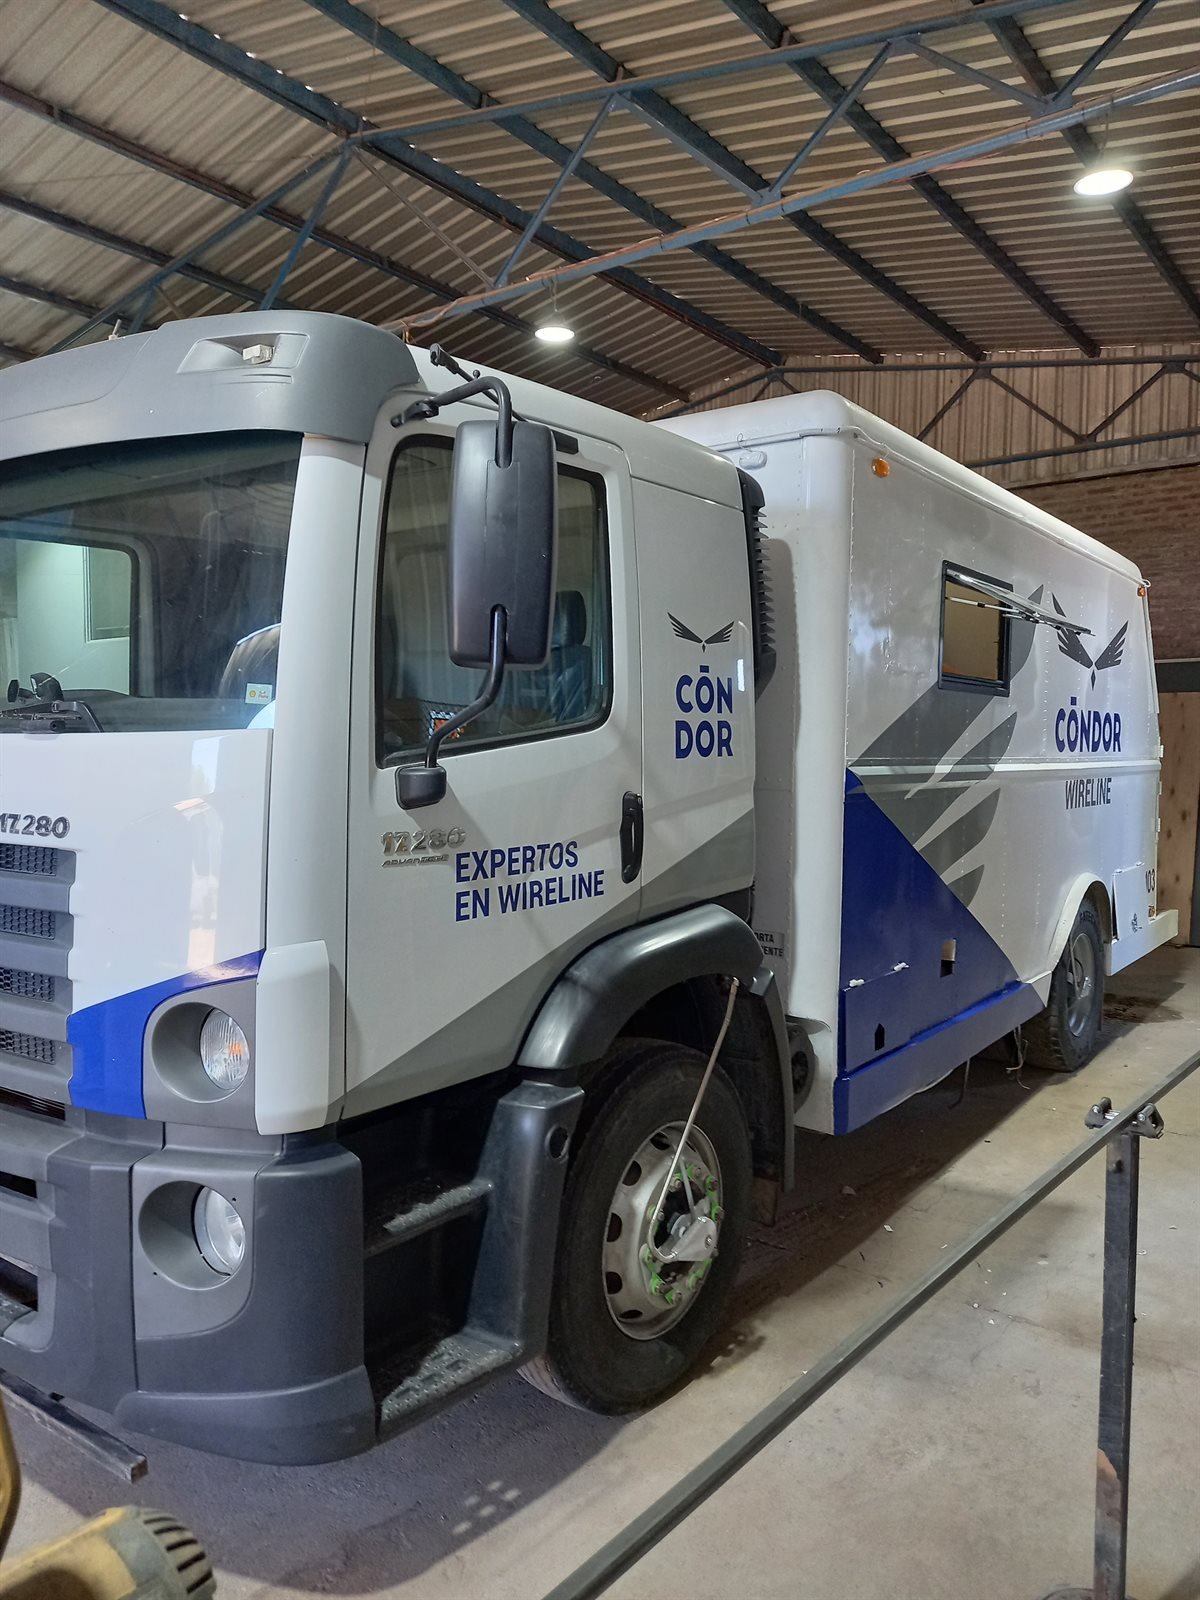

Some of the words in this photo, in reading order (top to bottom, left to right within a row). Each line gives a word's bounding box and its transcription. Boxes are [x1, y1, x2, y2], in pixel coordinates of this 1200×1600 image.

[675, 720, 733, 759] DOR
[1065, 777, 1112, 810] WIRELINE
[455, 840, 579, 884] EXPERTOS
[455, 887, 490, 922] EN
[497, 869, 605, 914] WIRELINE
